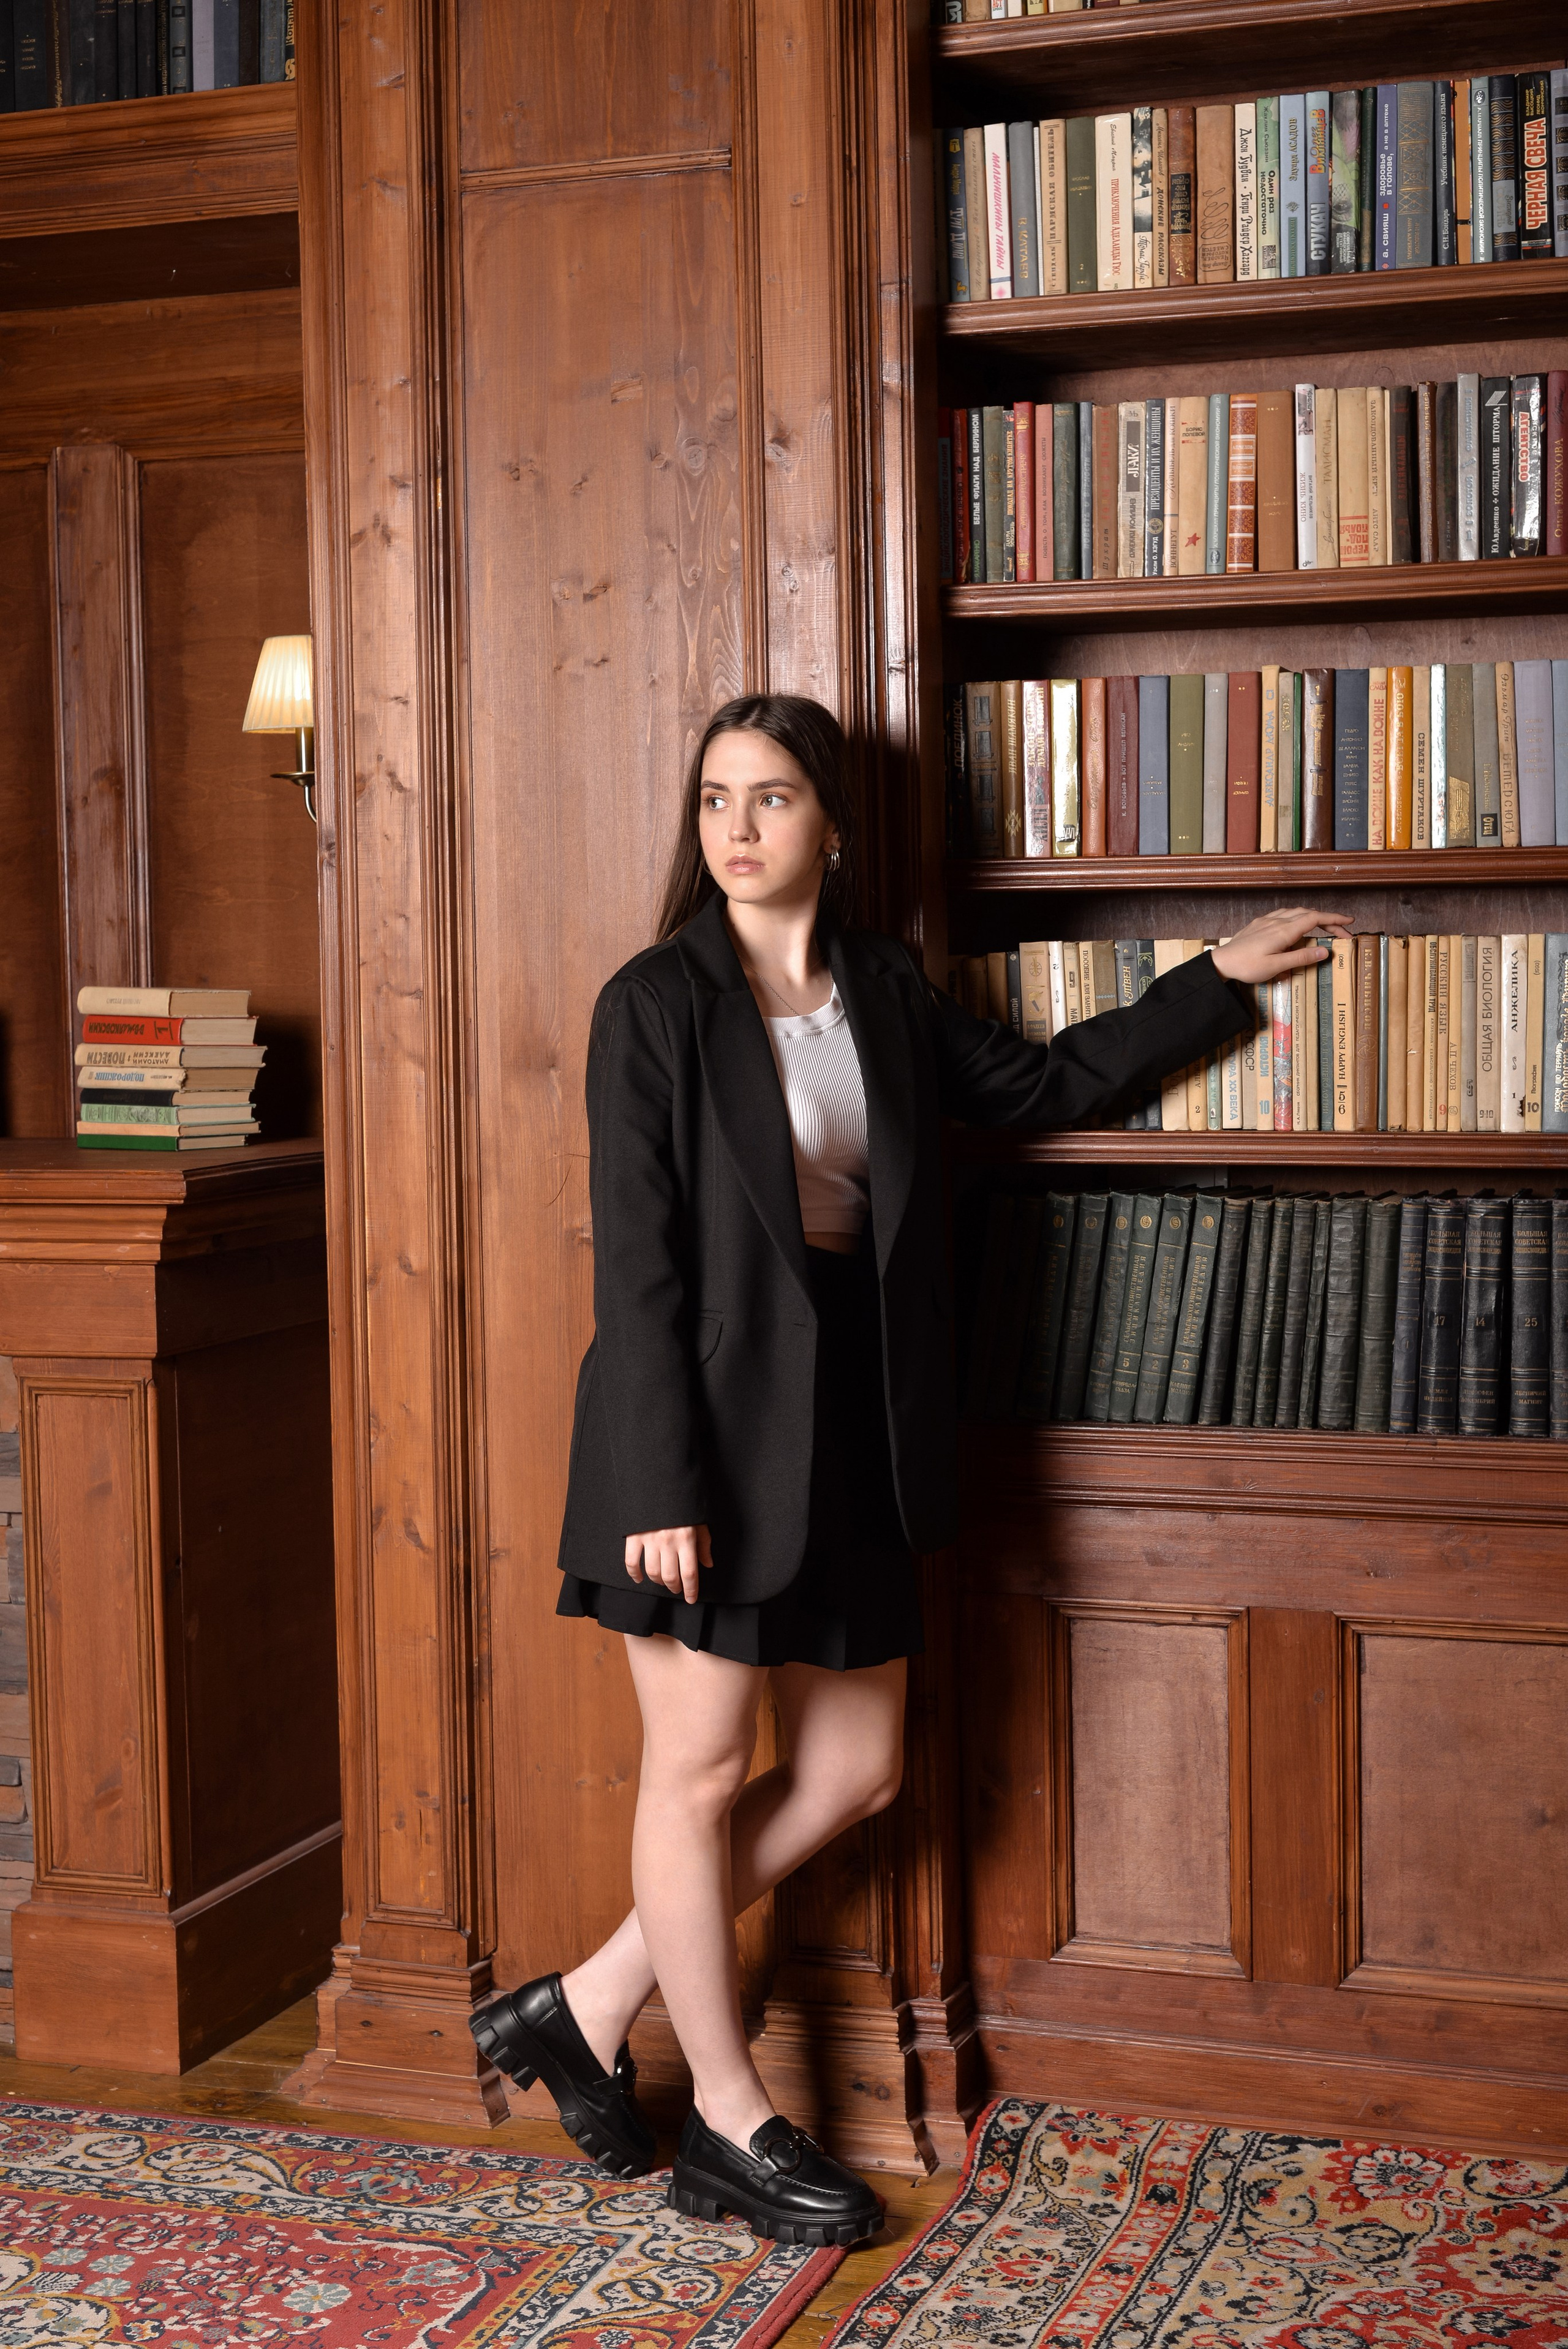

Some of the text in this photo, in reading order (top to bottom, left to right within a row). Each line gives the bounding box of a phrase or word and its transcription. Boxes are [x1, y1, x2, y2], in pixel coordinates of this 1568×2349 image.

[1289, 118, 1299, 181] Эдуард АСАДОВ
[1524, 117, 1547, 229] ЧЕРНАЯ СВЕЧА
[992, 153, 1005, 270] МАЛЬЧИШКИНЫ ТАЙНЫ
[1110, 178, 1119, 225] ПРИКЛЮЧЕНИЯ
[1238, 129, 1253, 275] Джон Гудвин Генри Райдер Хаггард
[1019, 230, 1028, 279] КАТАЕВ
[1138, 235, 1149, 259] Томас
[1311, 202, 1327, 260] СТУКАЧ
[1112, 263, 1121, 276] ГЮС
[1150, 407, 1161, 445] ЖЕНЩИНЫ
[1323, 420, 1332, 484] ТАЛИСМАН
[1492, 406, 1501, 496] ОЖИДАНИЕ ШТОРМА
[1518, 412, 1530, 482] АГЕНТСТВО
[1126, 444, 1139, 477] ЛАКИ
[1150, 466, 1161, 510] ПРЕЗИДЕНТЫ
[1554, 438, 1564, 537] Ольга КОЖУХОВА
[953, 698, 963, 767] ПОЕДИНОК
[1008, 699, 1017, 774] ИВАН ШАМЯКИН
[1036, 687, 1046, 767] ДУМАЙ БОГАТЕЙ
[1503, 716, 1512, 742] Грин
[1265, 748, 1274, 807] АЛЕКСАНДР
[1372, 699, 1384, 845] НА ВОЙНЕ КАК НА ВОЙНЕ
[1505, 810, 1515, 834] ЮГА
[1259, 983, 1268, 1077] ИСТОРИЯ ОТЕЧЕСТВА
[1482, 948, 1493, 1071] ОБЩАЯ БИОЛОГИЯ
[86, 1052, 126, 1064] ПОВЕСТИ
[95, 1071, 145, 1082] ПОДОРОЖНИК
[1245, 1036, 1254, 1071] РСФСР
[1230, 1095, 1238, 1120] ВЕКА
[1527, 1103, 1540, 1113] 10
[1123, 1255, 1140, 1342] СЕЛЬСКОХОЗЯЙСТВЕННАЯ
[1130, 1256, 1147, 1343] ЭНЦИКЛОПЕДИЯ
[1183, 1256, 1202, 1343] СЕЛЬСКОХОЗЯЙСТВЕННАЯ
[1189, 1257, 1208, 1344] ЭНЦИКЛОПЕДИЯ
[1435, 1316, 1445, 1325] 17
[1476, 1318, 1485, 1326] 14
[1525, 1318, 1537, 1327] 25
[1123, 1357, 1129, 1367] 5
[1152, 1359, 1158, 1368] 2
[1183, 1359, 1189, 1368] 3
